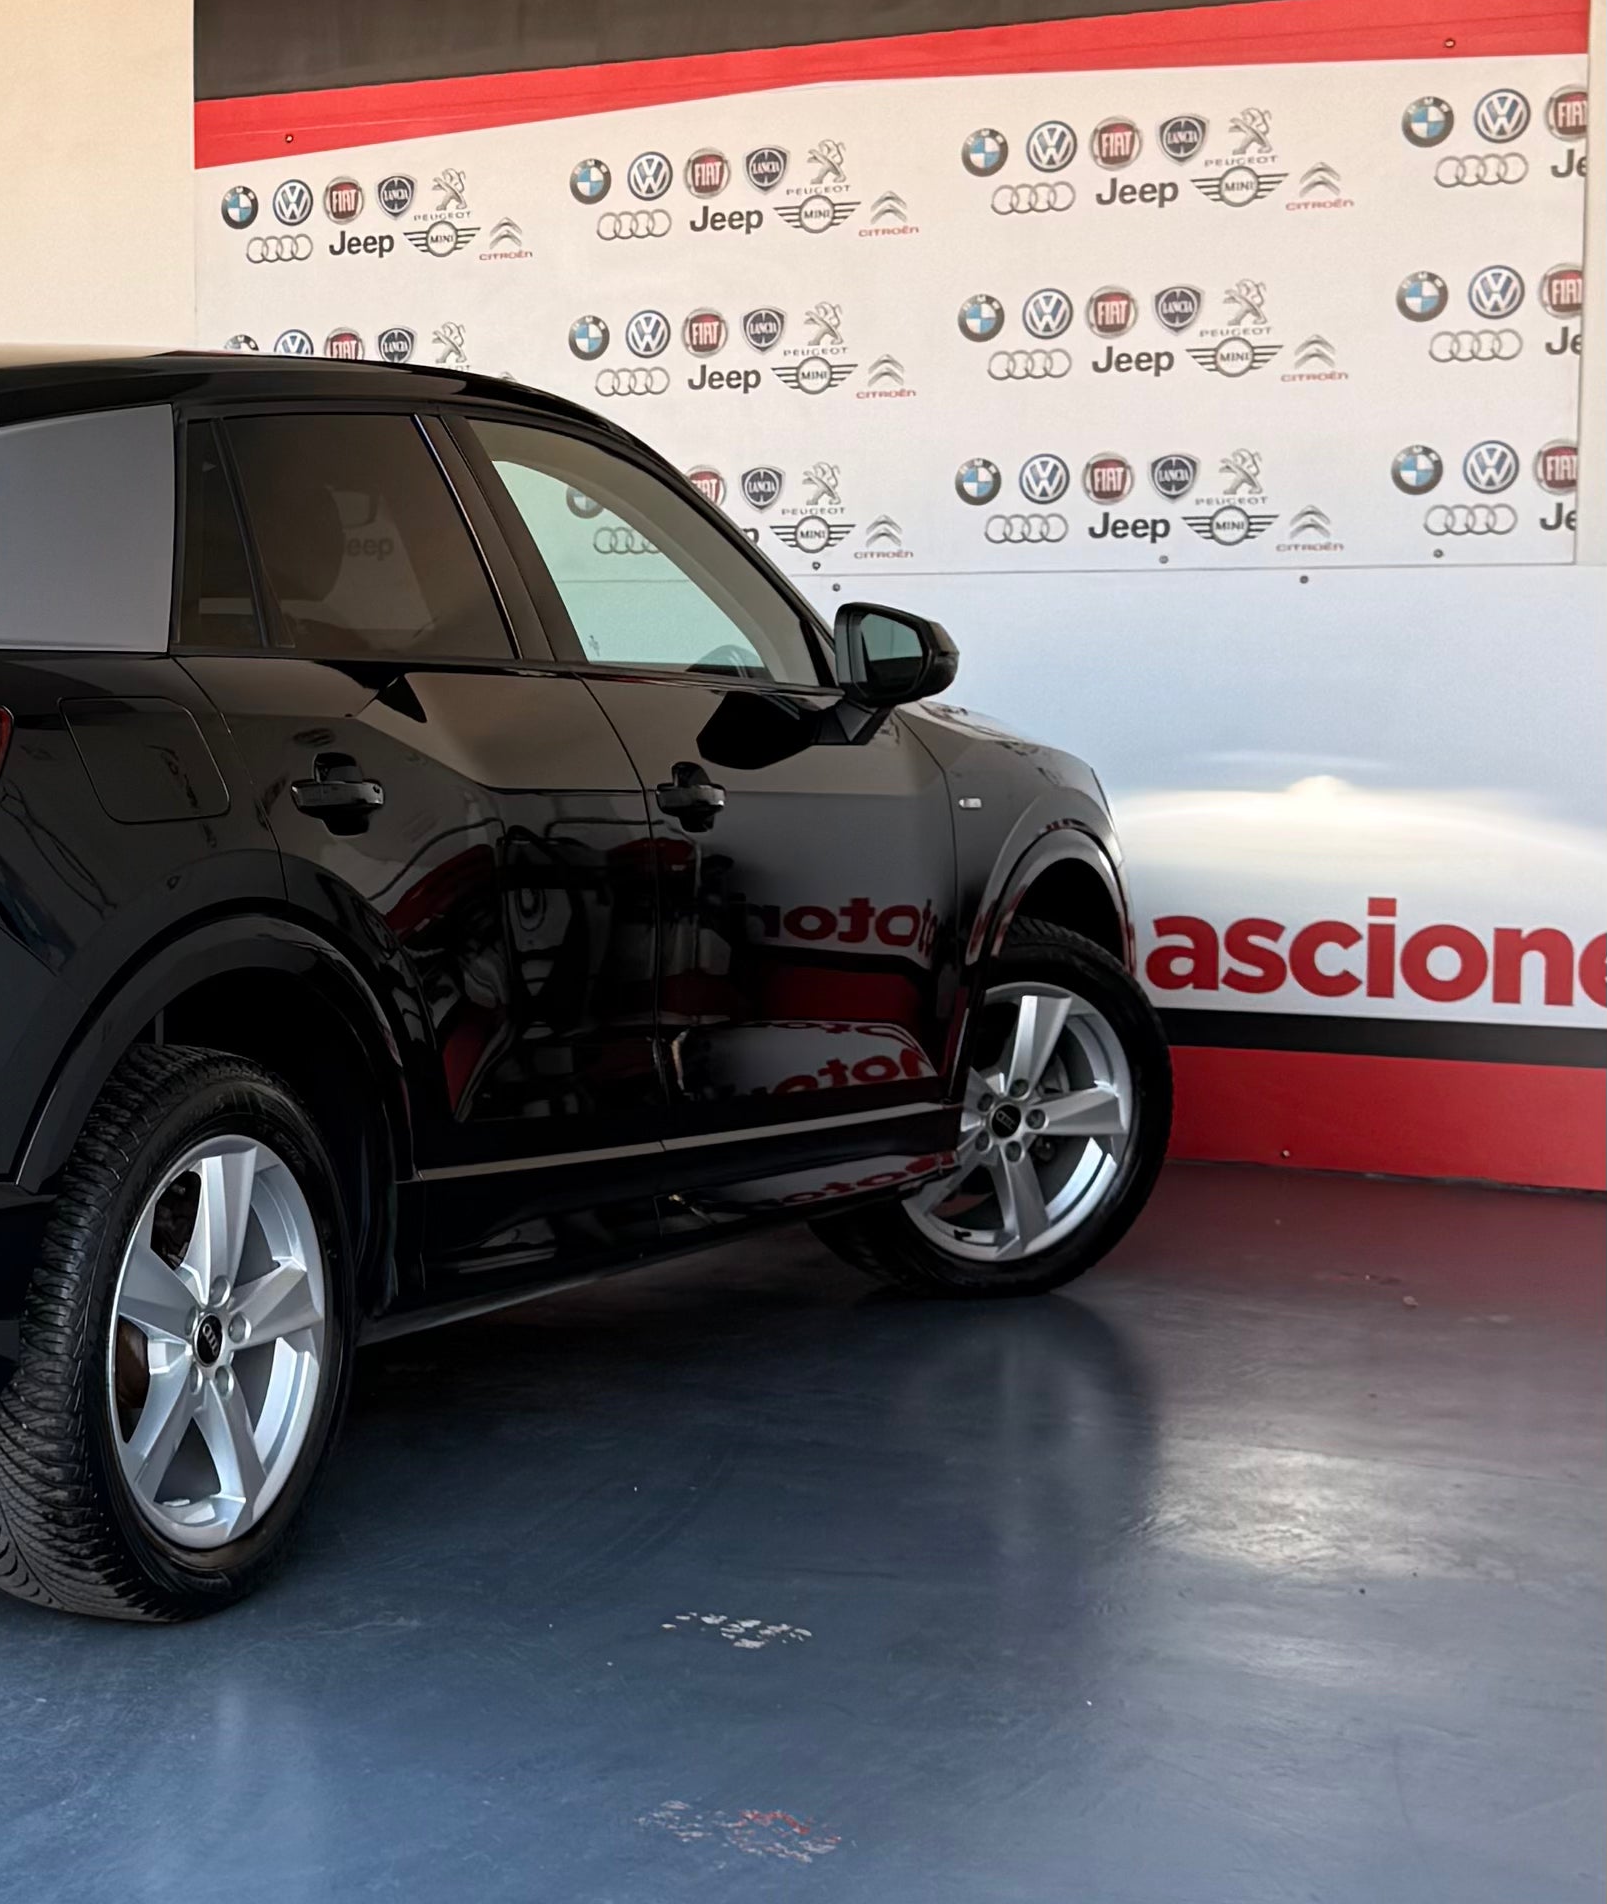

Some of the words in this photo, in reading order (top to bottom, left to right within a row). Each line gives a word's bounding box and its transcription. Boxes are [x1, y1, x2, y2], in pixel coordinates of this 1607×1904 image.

[1101, 131, 1132, 158] FIAT
[694, 161, 722, 187] FIAT
[1225, 181, 1255, 192] MINI
[332, 189, 357, 213] FIAT
[1095, 177, 1179, 208] Jeep
[690, 205, 763, 234] Jeep
[804, 210, 830, 219] MINI
[329, 230, 395, 259] Jeep
[429, 235, 454, 244] MINI
[1097, 300, 1128, 326] FIAT
[692, 321, 720, 346] FIAT
[1091, 346, 1175, 377] Jeep
[1219, 351, 1250, 363] MINI
[688, 364, 761, 394] Jeep
[801, 370, 828, 380] MINI
[1094, 467, 1124, 492] FIAT
[799, 531, 827, 539] MINI
[1088, 512, 1171, 544] Jeep
[1215, 520, 1244, 531] MINI
